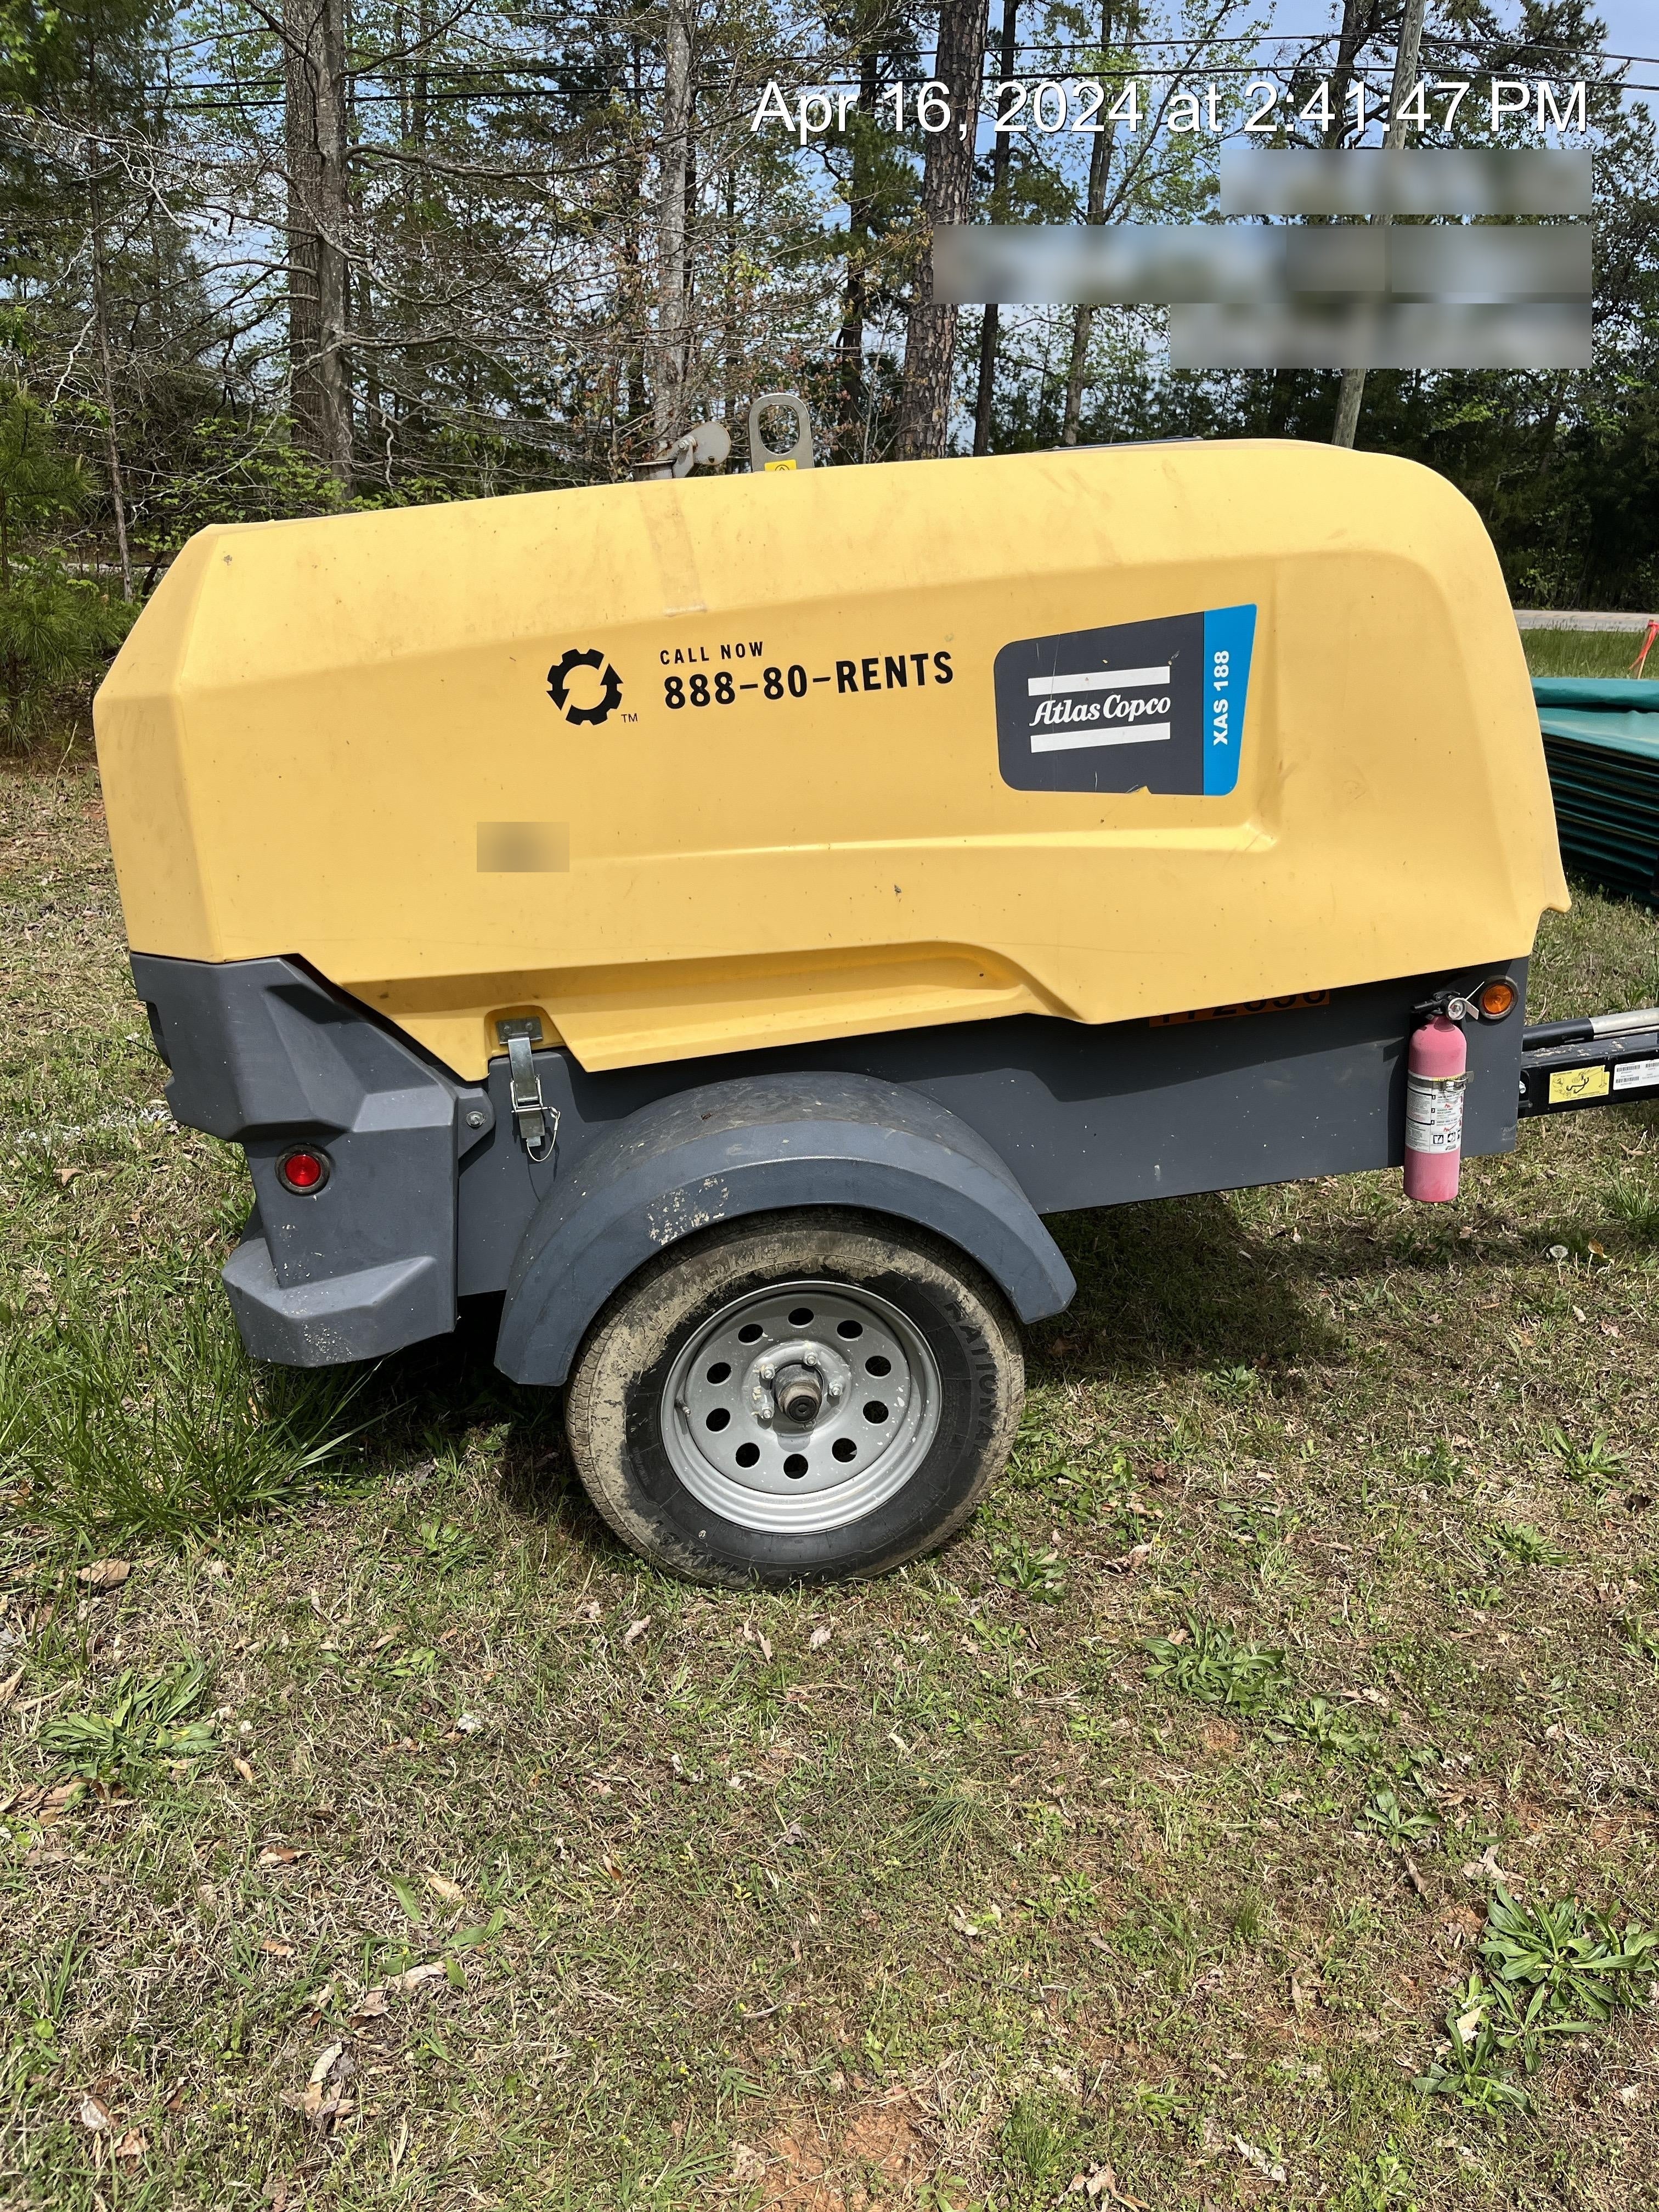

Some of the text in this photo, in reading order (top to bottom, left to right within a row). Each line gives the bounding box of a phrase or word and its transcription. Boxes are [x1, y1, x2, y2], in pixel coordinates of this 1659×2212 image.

[660, 641, 763, 665] CALL NOW
[664, 651, 953, 709] 888-80-RENTS
[1213, 650, 1229, 746] XAS 188
[620, 713, 638, 724] TM
